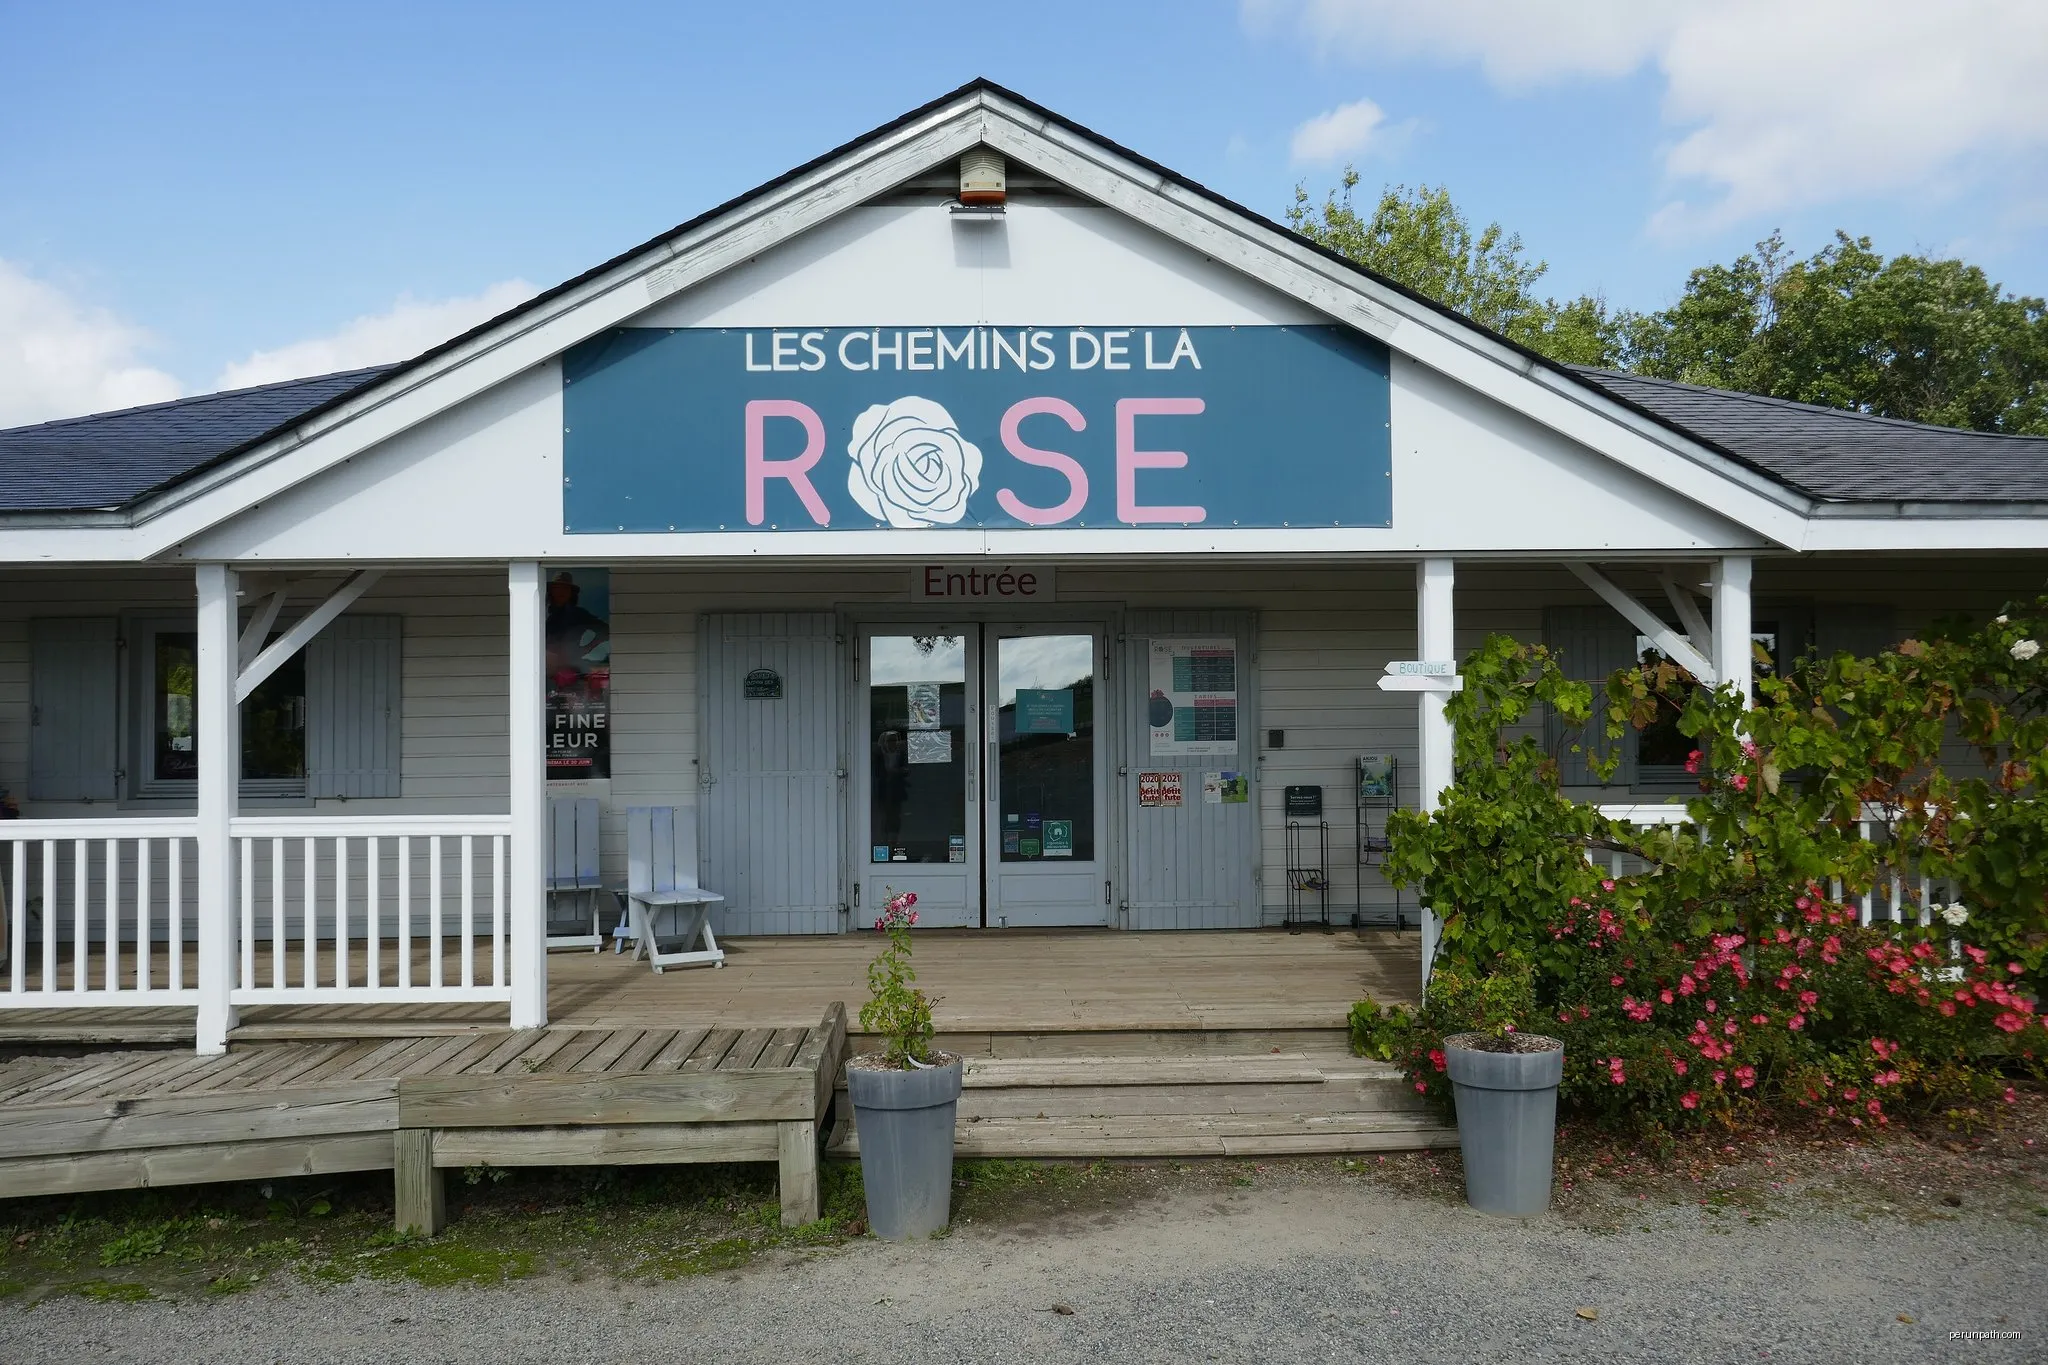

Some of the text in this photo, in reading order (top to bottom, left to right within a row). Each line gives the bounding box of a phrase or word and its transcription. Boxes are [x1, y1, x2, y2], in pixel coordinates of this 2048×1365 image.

[746, 328, 1202, 373] LES CHEMINS DE LA
[924, 566, 1037, 596] Entrée
[555, 713, 606, 729] FINE
[1140, 775, 1159, 783] 2020
[1162, 774, 1180, 782] 2021
